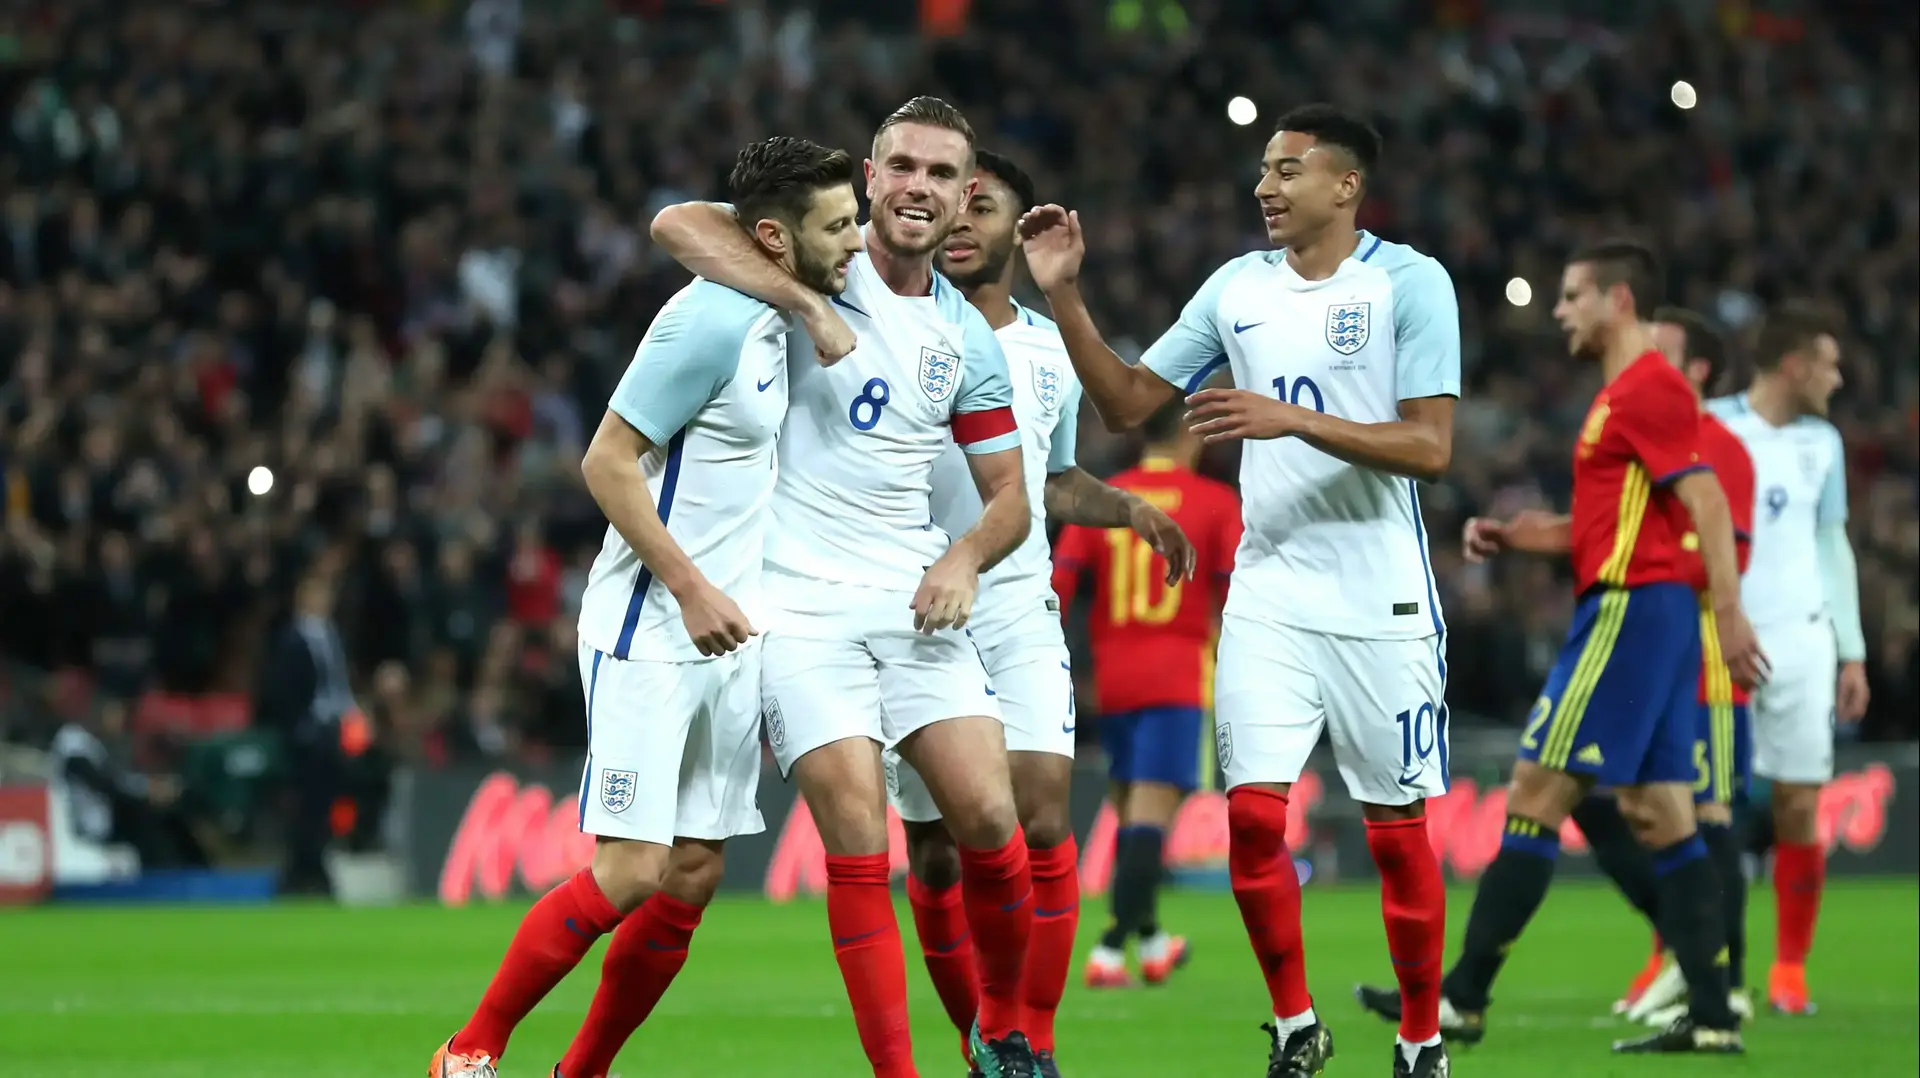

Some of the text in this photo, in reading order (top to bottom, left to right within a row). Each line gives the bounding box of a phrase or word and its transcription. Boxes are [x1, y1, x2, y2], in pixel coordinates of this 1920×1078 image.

[849, 377, 890, 431] 8
[1765, 484, 1789, 524] 9
[1105, 526, 1183, 627] 10
[1396, 702, 1434, 767] 10
